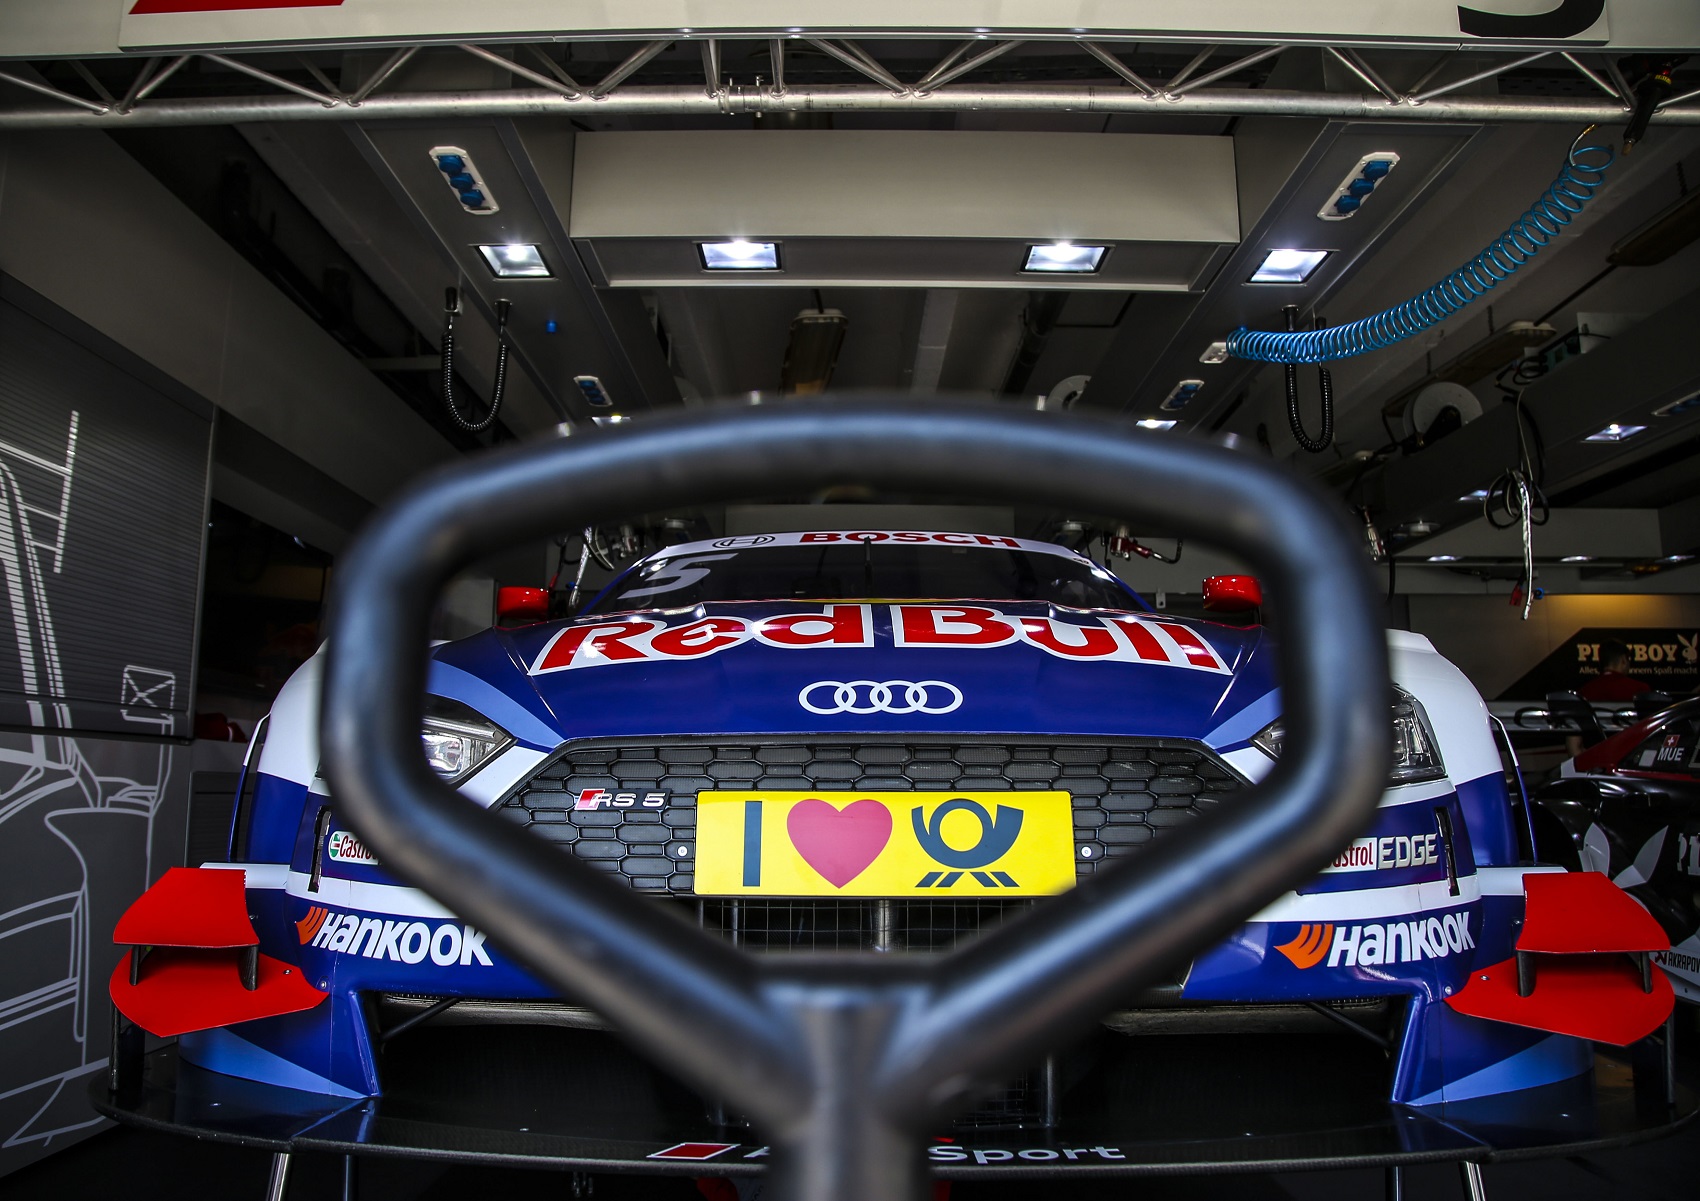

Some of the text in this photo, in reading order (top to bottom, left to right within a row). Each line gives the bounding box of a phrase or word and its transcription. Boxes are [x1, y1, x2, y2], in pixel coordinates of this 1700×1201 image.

[800, 532, 1022, 548] BOSCH
[617, 553, 739, 599] 5
[536, 604, 1222, 672] Red Bull
[1657, 747, 1684, 761] MUE
[589, 792, 666, 807] RS 5
[1377, 833, 1439, 870] EDGE
[928, 1145, 1125, 1164] Sport
